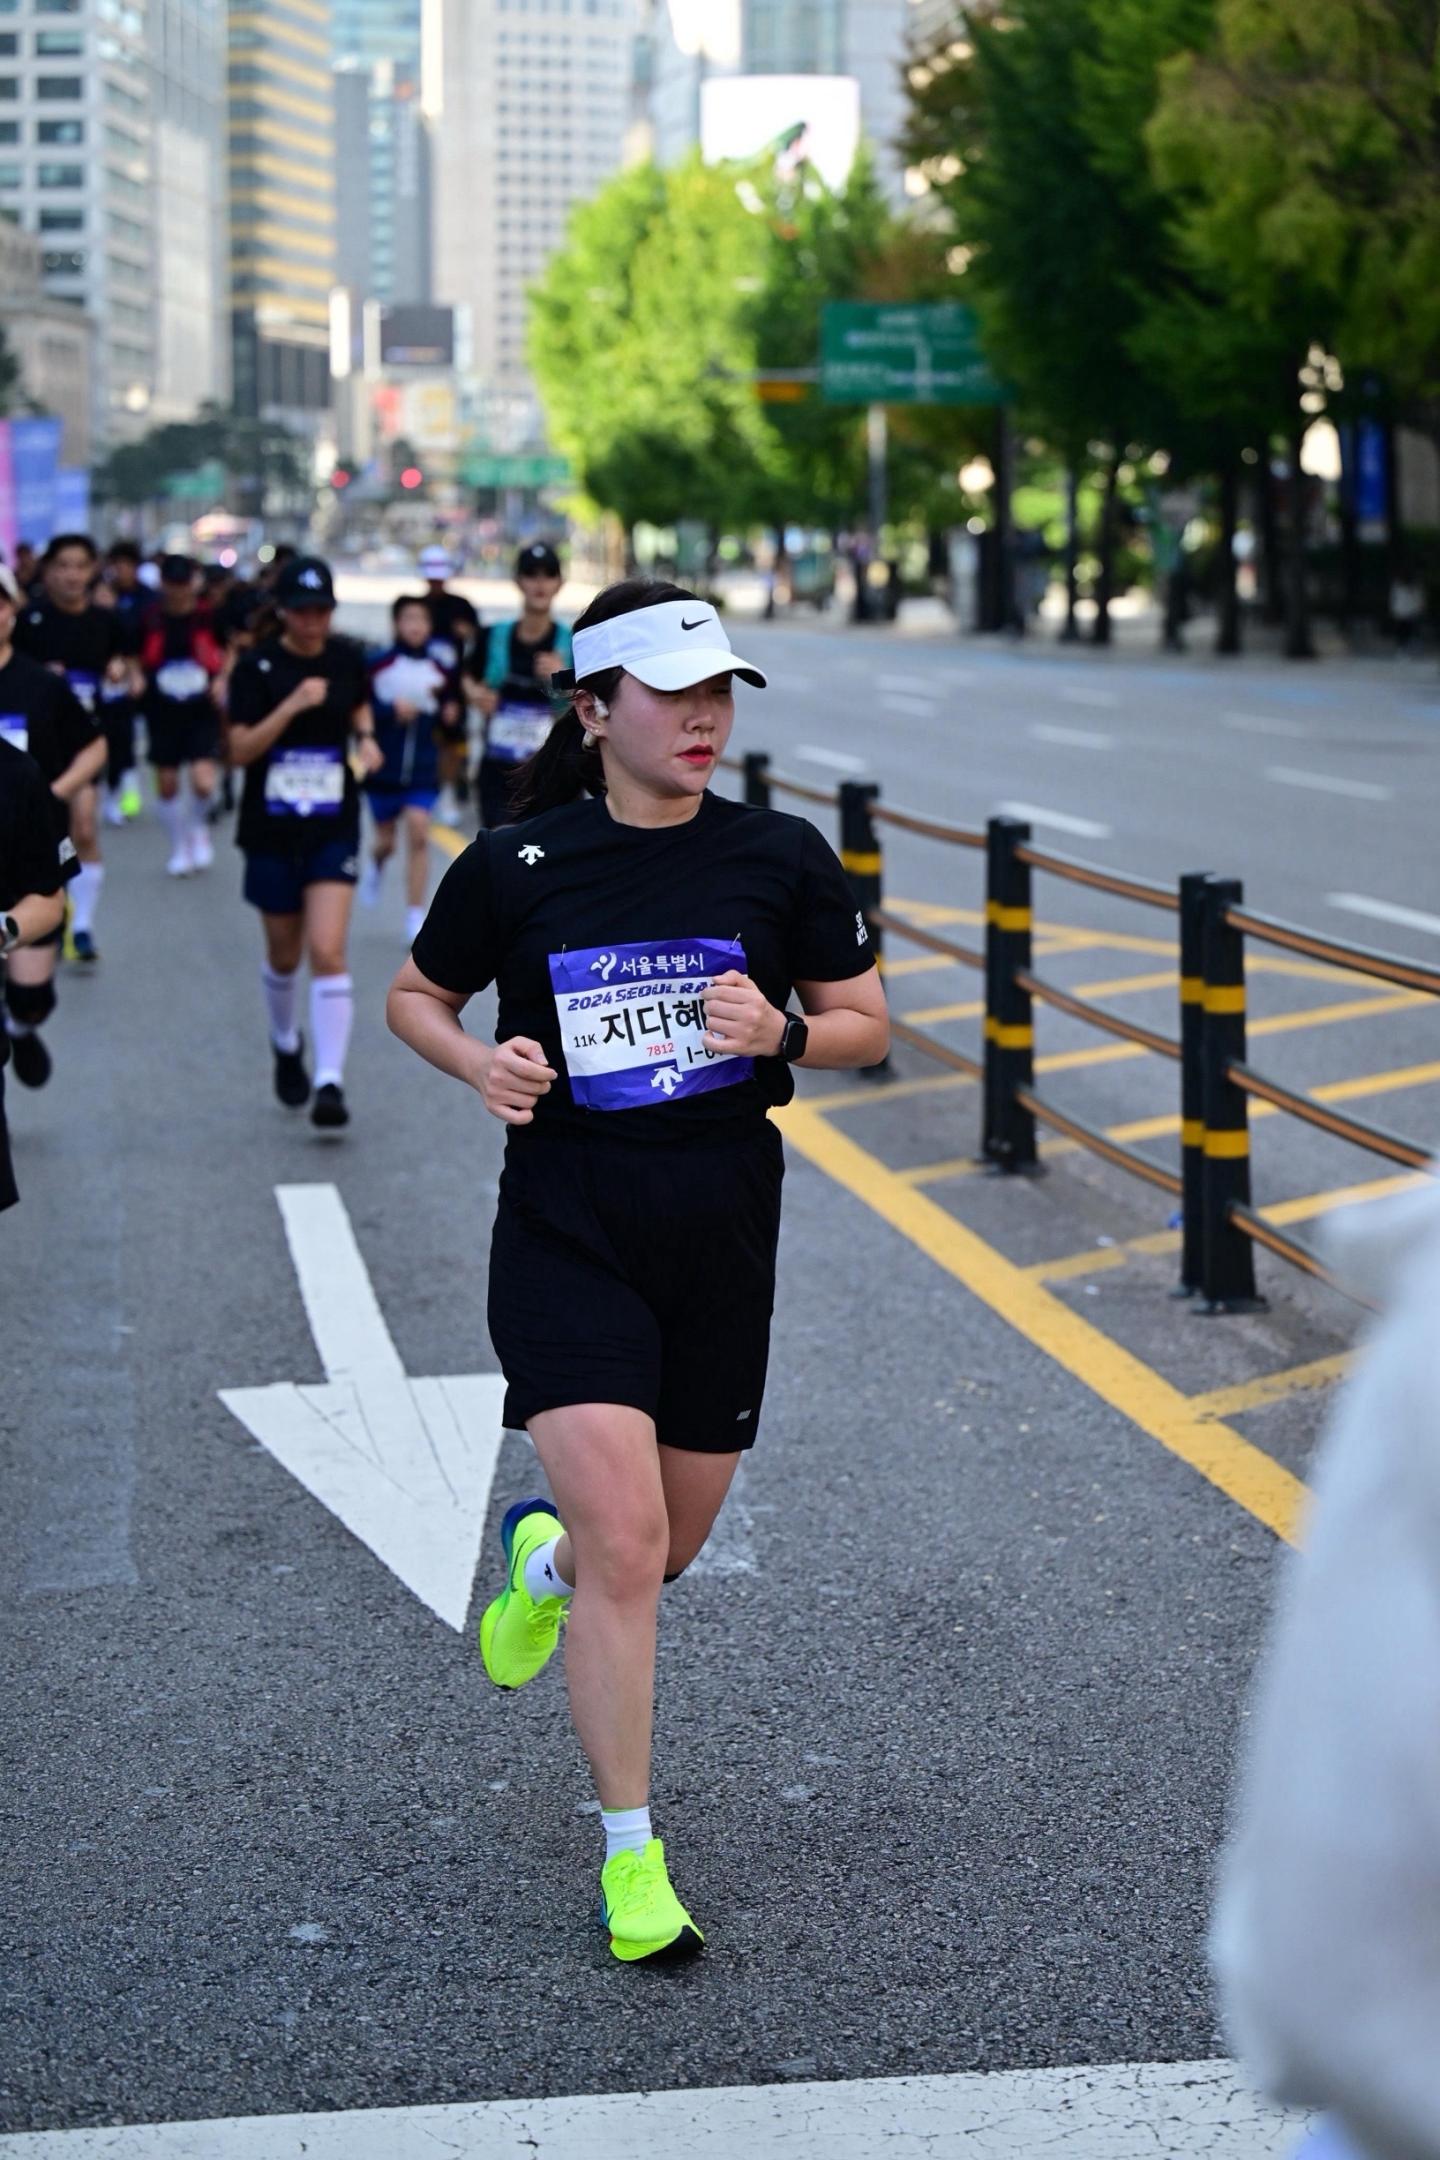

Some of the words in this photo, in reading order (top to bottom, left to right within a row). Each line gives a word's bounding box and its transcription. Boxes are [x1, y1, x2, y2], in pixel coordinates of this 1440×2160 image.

[620, 953, 704, 976] 서울특별시
[567, 991, 613, 1011] 2024
[615, 983, 676, 1002] SEOUL
[679, 981, 716, 994] RA
[600, 999, 708, 1046] 지다혜
[573, 1033, 598, 1048] 11K
[646, 1042, 675, 1057] 7812
